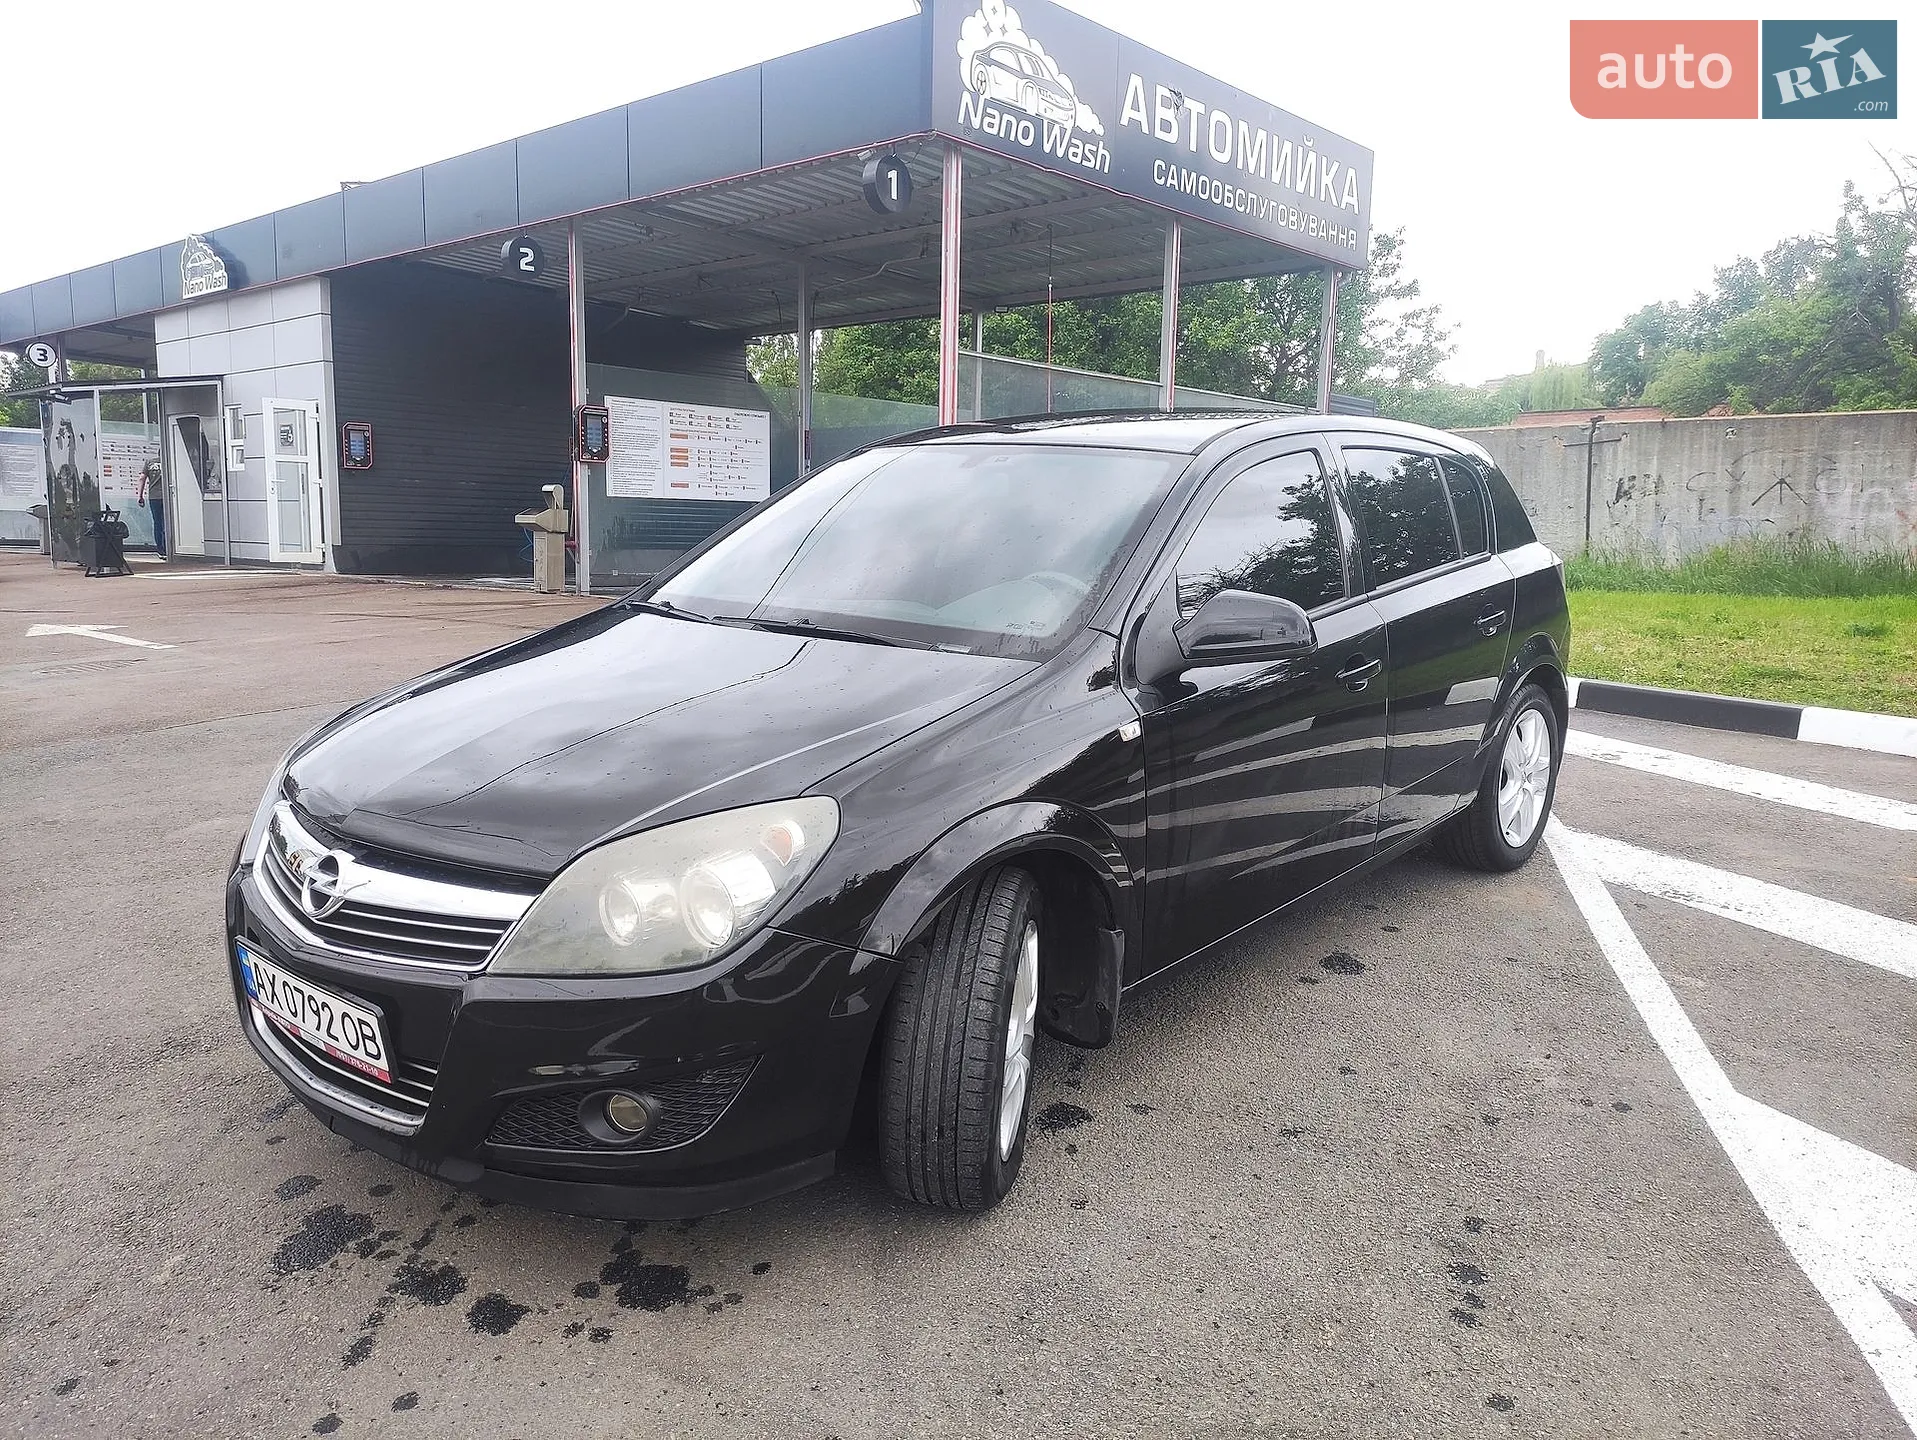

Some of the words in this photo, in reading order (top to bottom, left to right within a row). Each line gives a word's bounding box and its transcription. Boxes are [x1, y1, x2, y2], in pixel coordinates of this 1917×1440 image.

[957, 91, 1035, 147] Nano
[1041, 115, 1112, 174] Wash
[1119, 72, 1360, 215] АВТОМИЙКА
[887, 169, 898, 200] 1
[1152, 158, 1358, 251] САМООБСЛУГОВУВАННЯ
[184, 281, 204, 295] Nano
[205, 272, 227, 290] Wash
[519, 247, 535, 271] 2
[36, 348, 48, 361] 3
[253, 961, 284, 1011] AX
[282, 980, 340, 1043] 0792
[341, 1011, 382, 1061] OB
